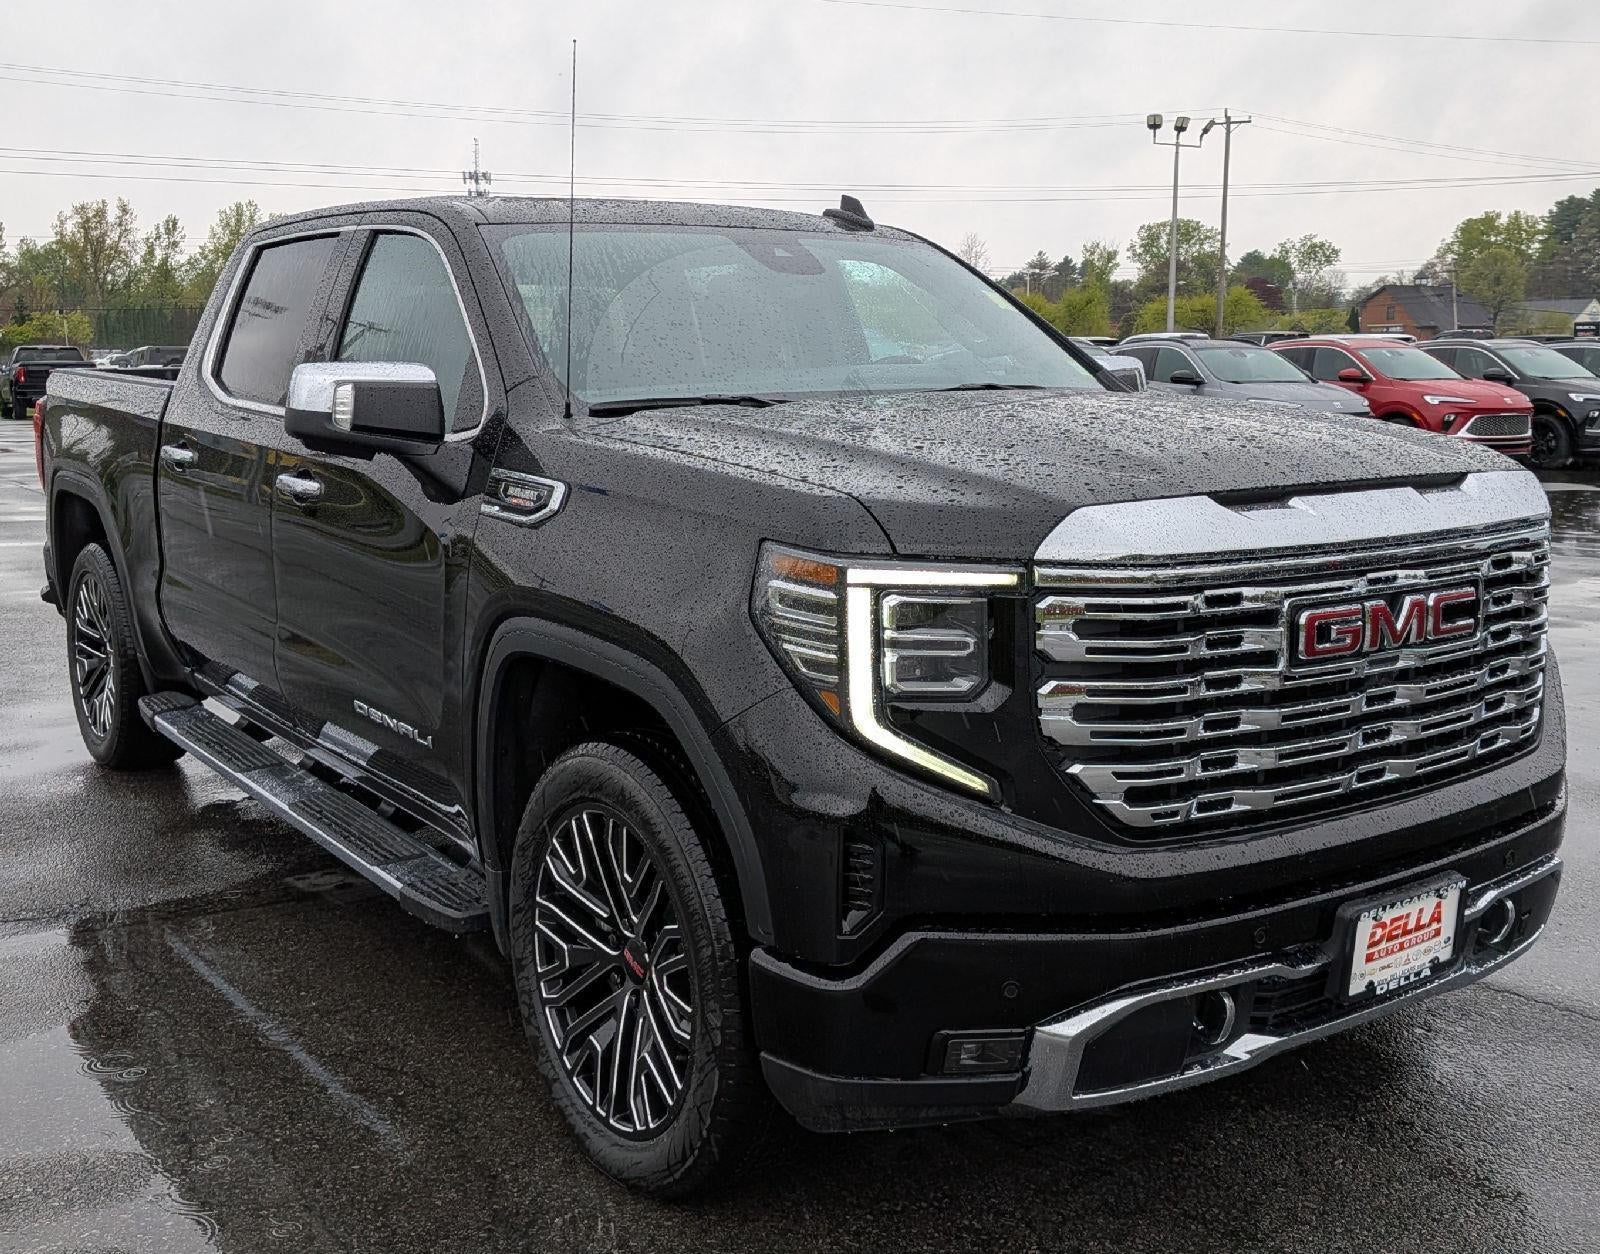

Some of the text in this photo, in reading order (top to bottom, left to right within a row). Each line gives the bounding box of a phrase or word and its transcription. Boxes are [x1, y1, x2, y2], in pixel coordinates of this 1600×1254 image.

[1299, 586, 1476, 659] GMC
[354, 700, 432, 749] DENALI
[1367, 900, 1441, 949] DELLA
[1373, 930, 1436, 960] AUTO GROUP
[1376, 967, 1431, 995] DELLA
